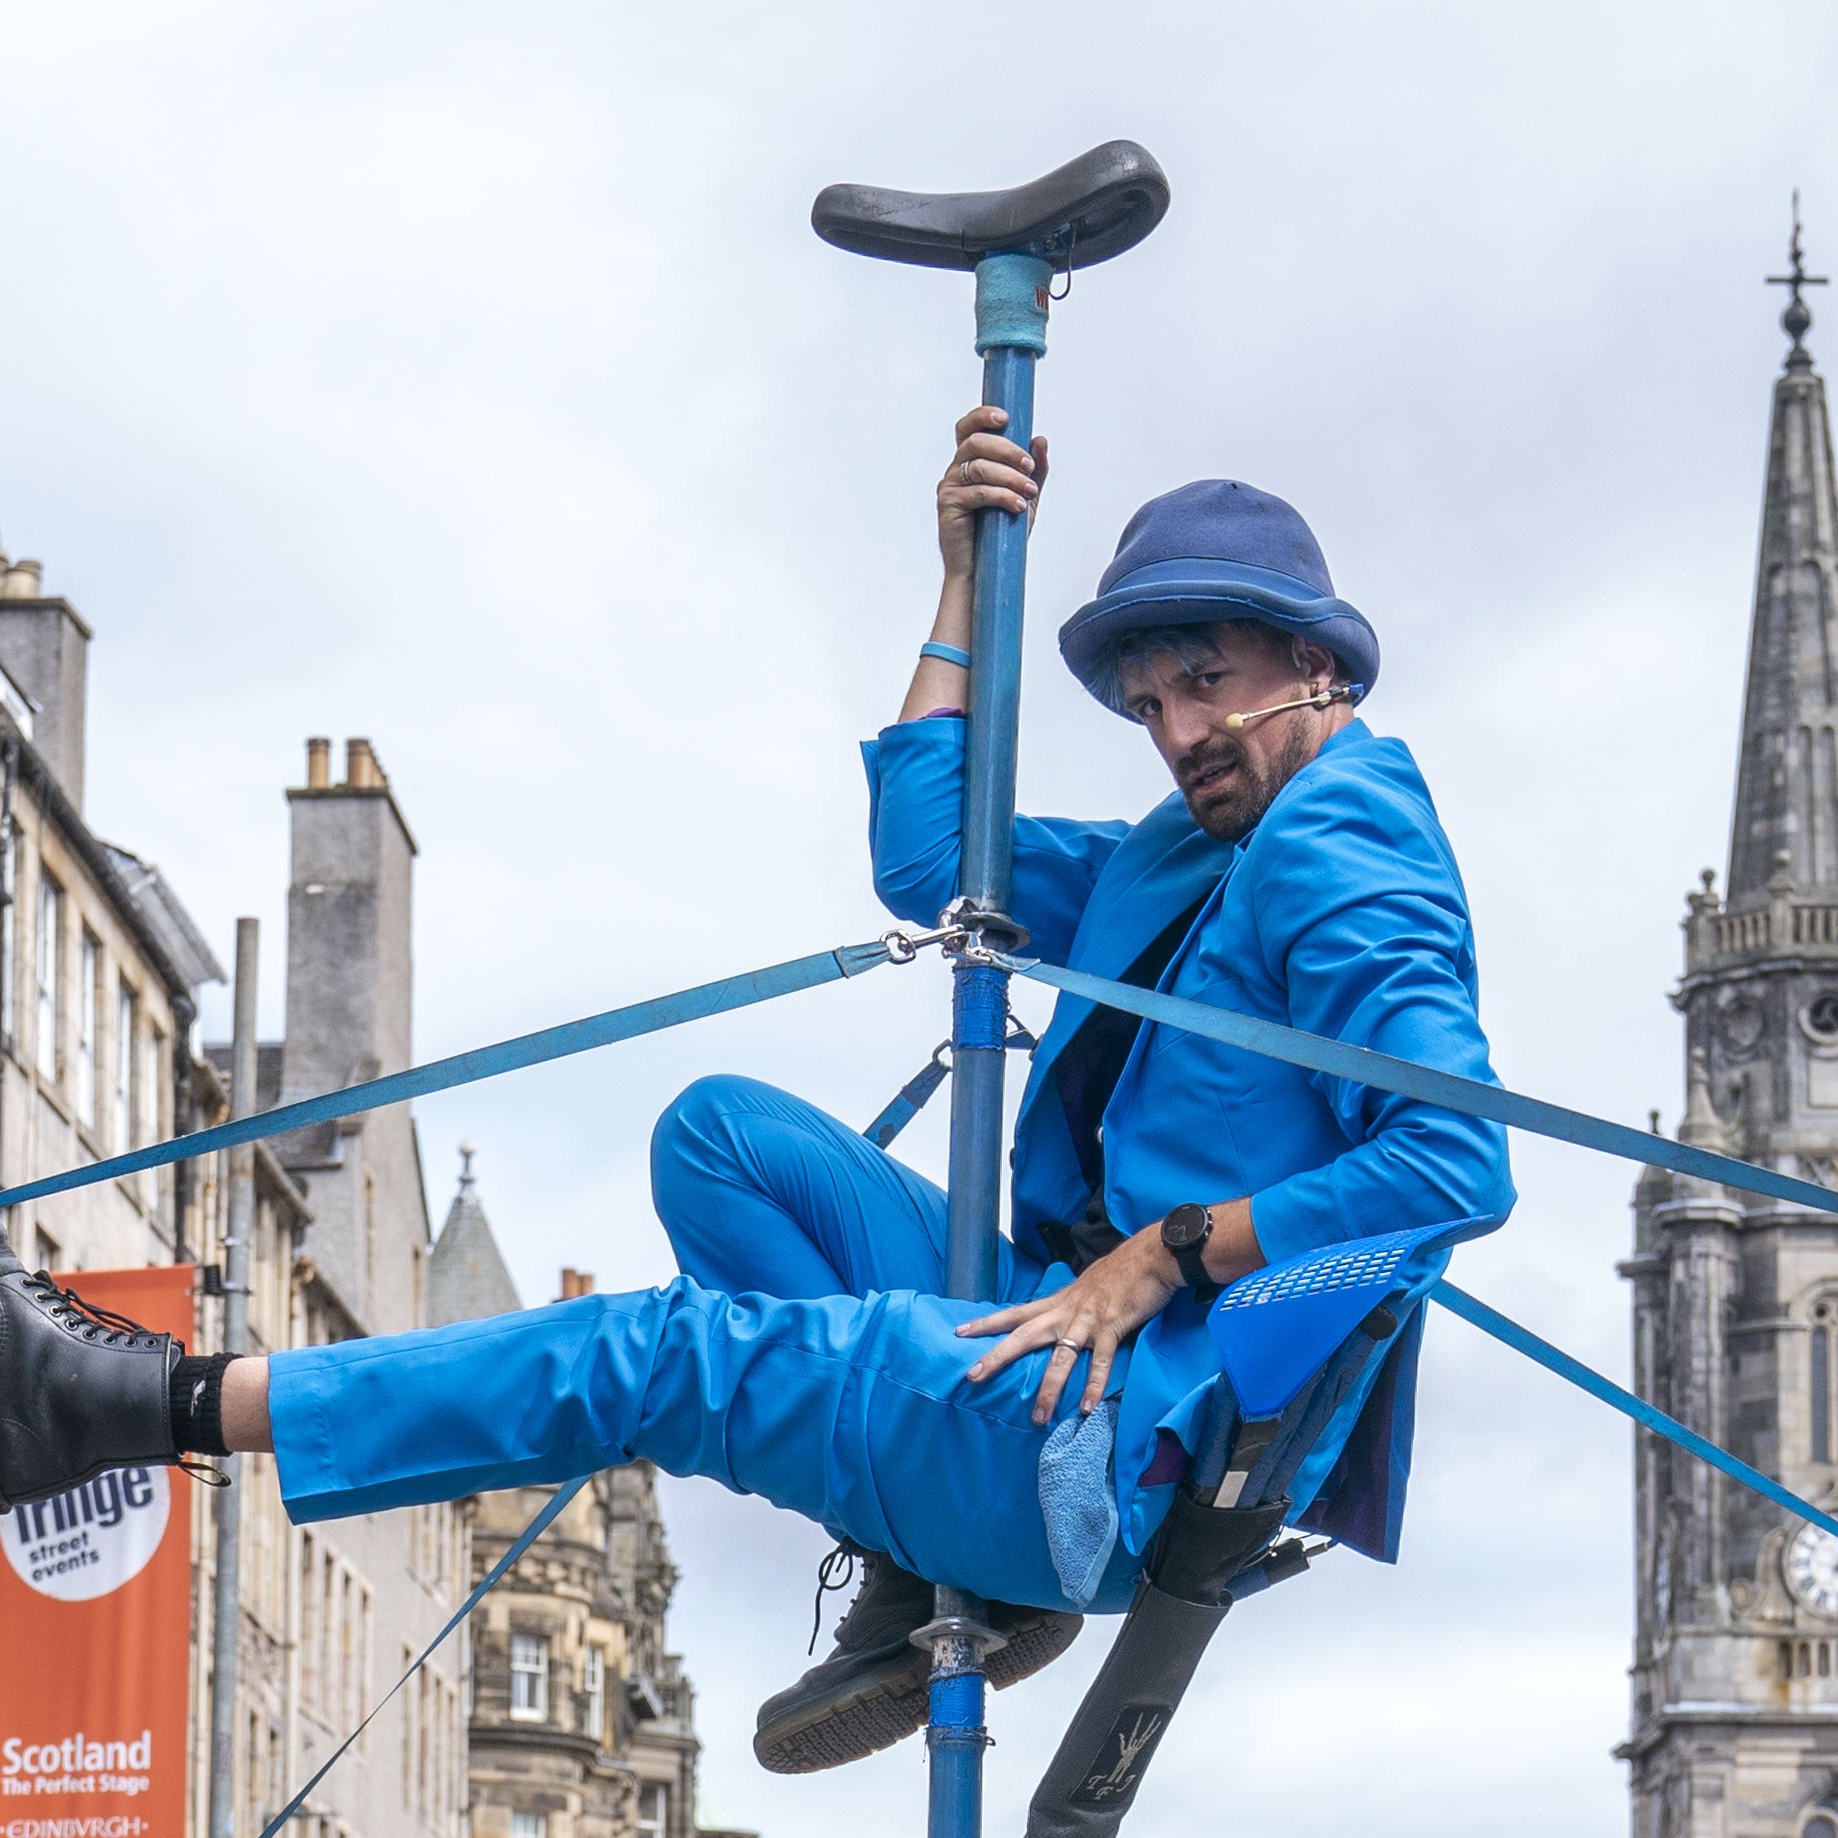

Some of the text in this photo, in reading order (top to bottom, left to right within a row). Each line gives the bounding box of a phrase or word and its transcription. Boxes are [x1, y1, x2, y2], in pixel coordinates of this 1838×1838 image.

[29, 1531, 89, 1564] street
[31, 1550, 100, 1582] events
[1, 1729, 152, 1775] Scotland
[1, 1772, 150, 1797] The Perfect Stage
